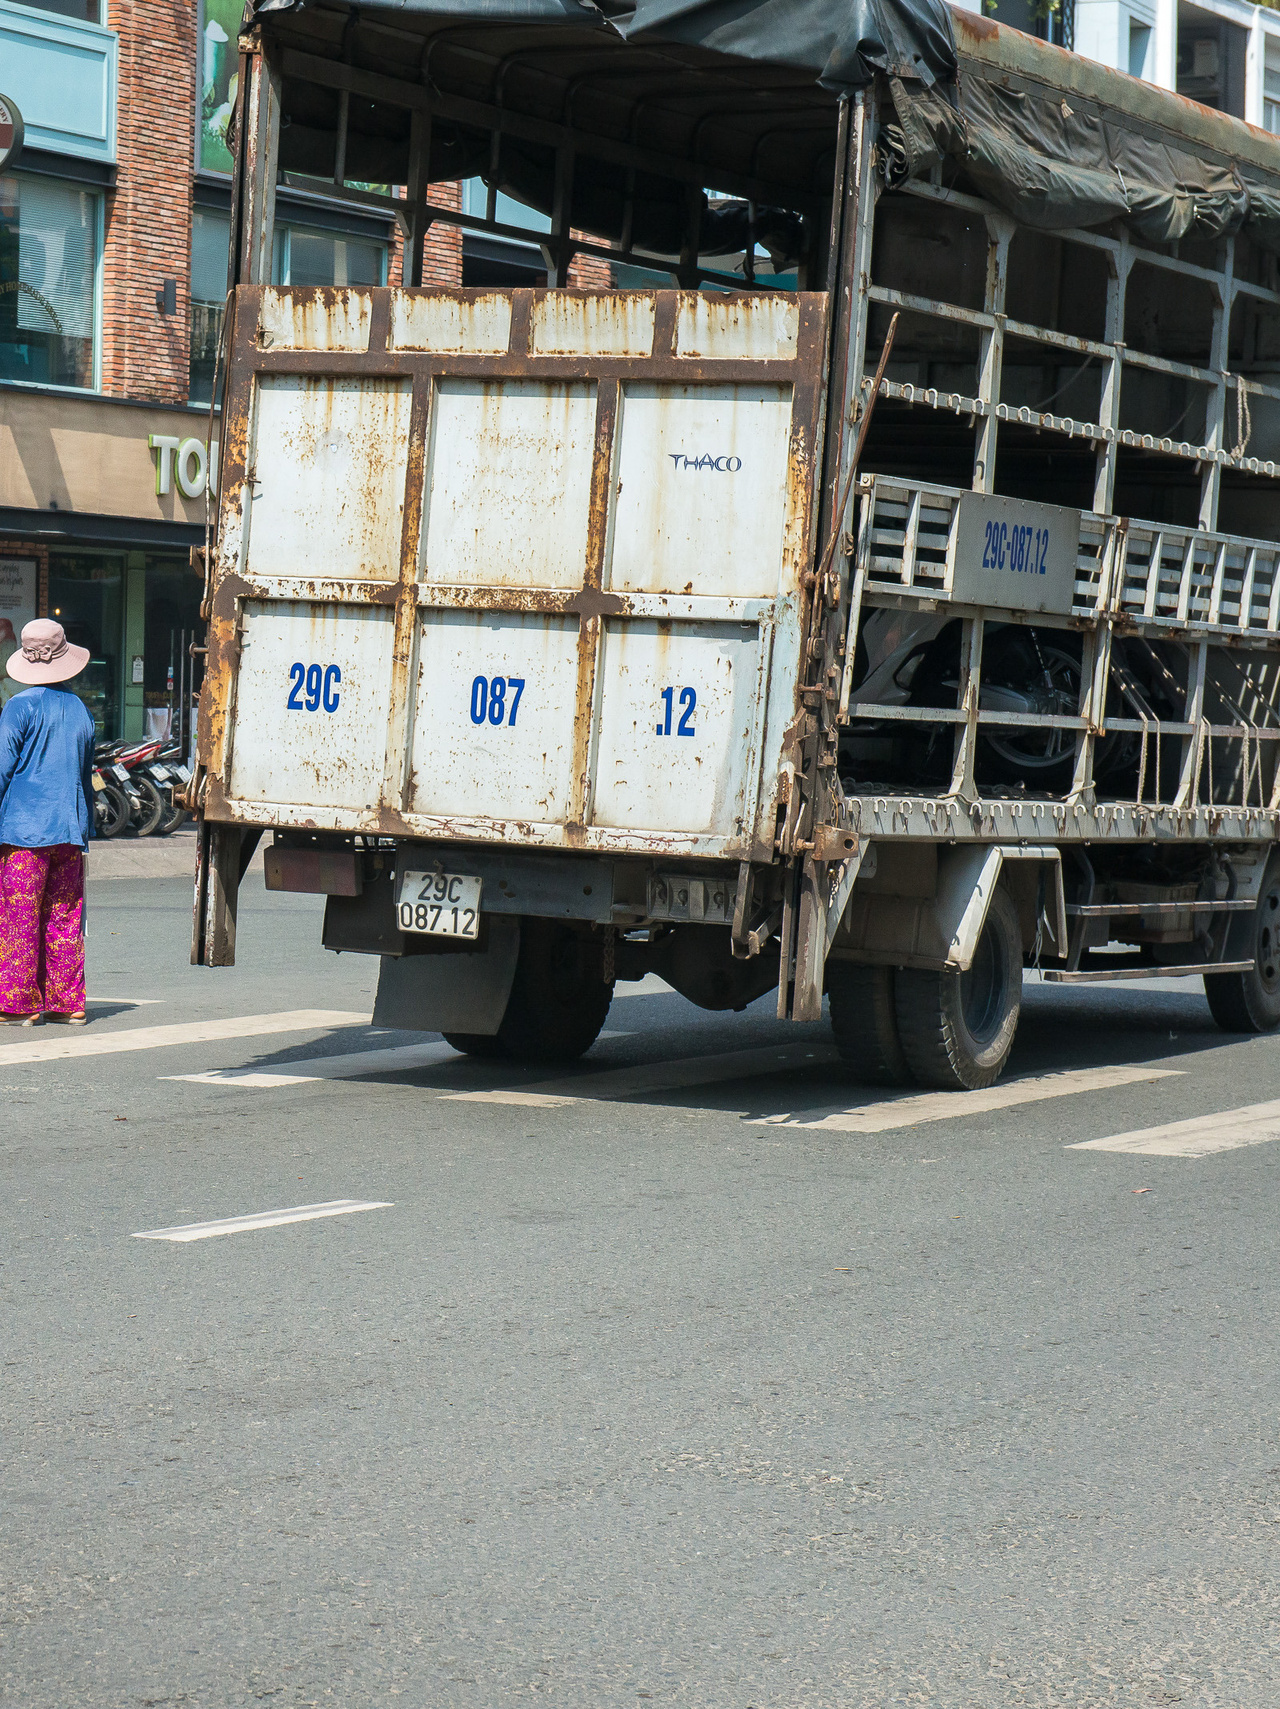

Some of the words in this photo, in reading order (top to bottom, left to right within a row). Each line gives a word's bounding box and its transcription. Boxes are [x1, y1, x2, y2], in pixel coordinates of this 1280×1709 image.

[668, 453, 742, 472] THACO
[982, 520, 1049, 575] 29C-087.12
[287, 662, 341, 714] 29C
[470, 675, 526, 727] 087
[417, 874, 463, 903] 29C
[400, 902, 476, 936] 087.12
